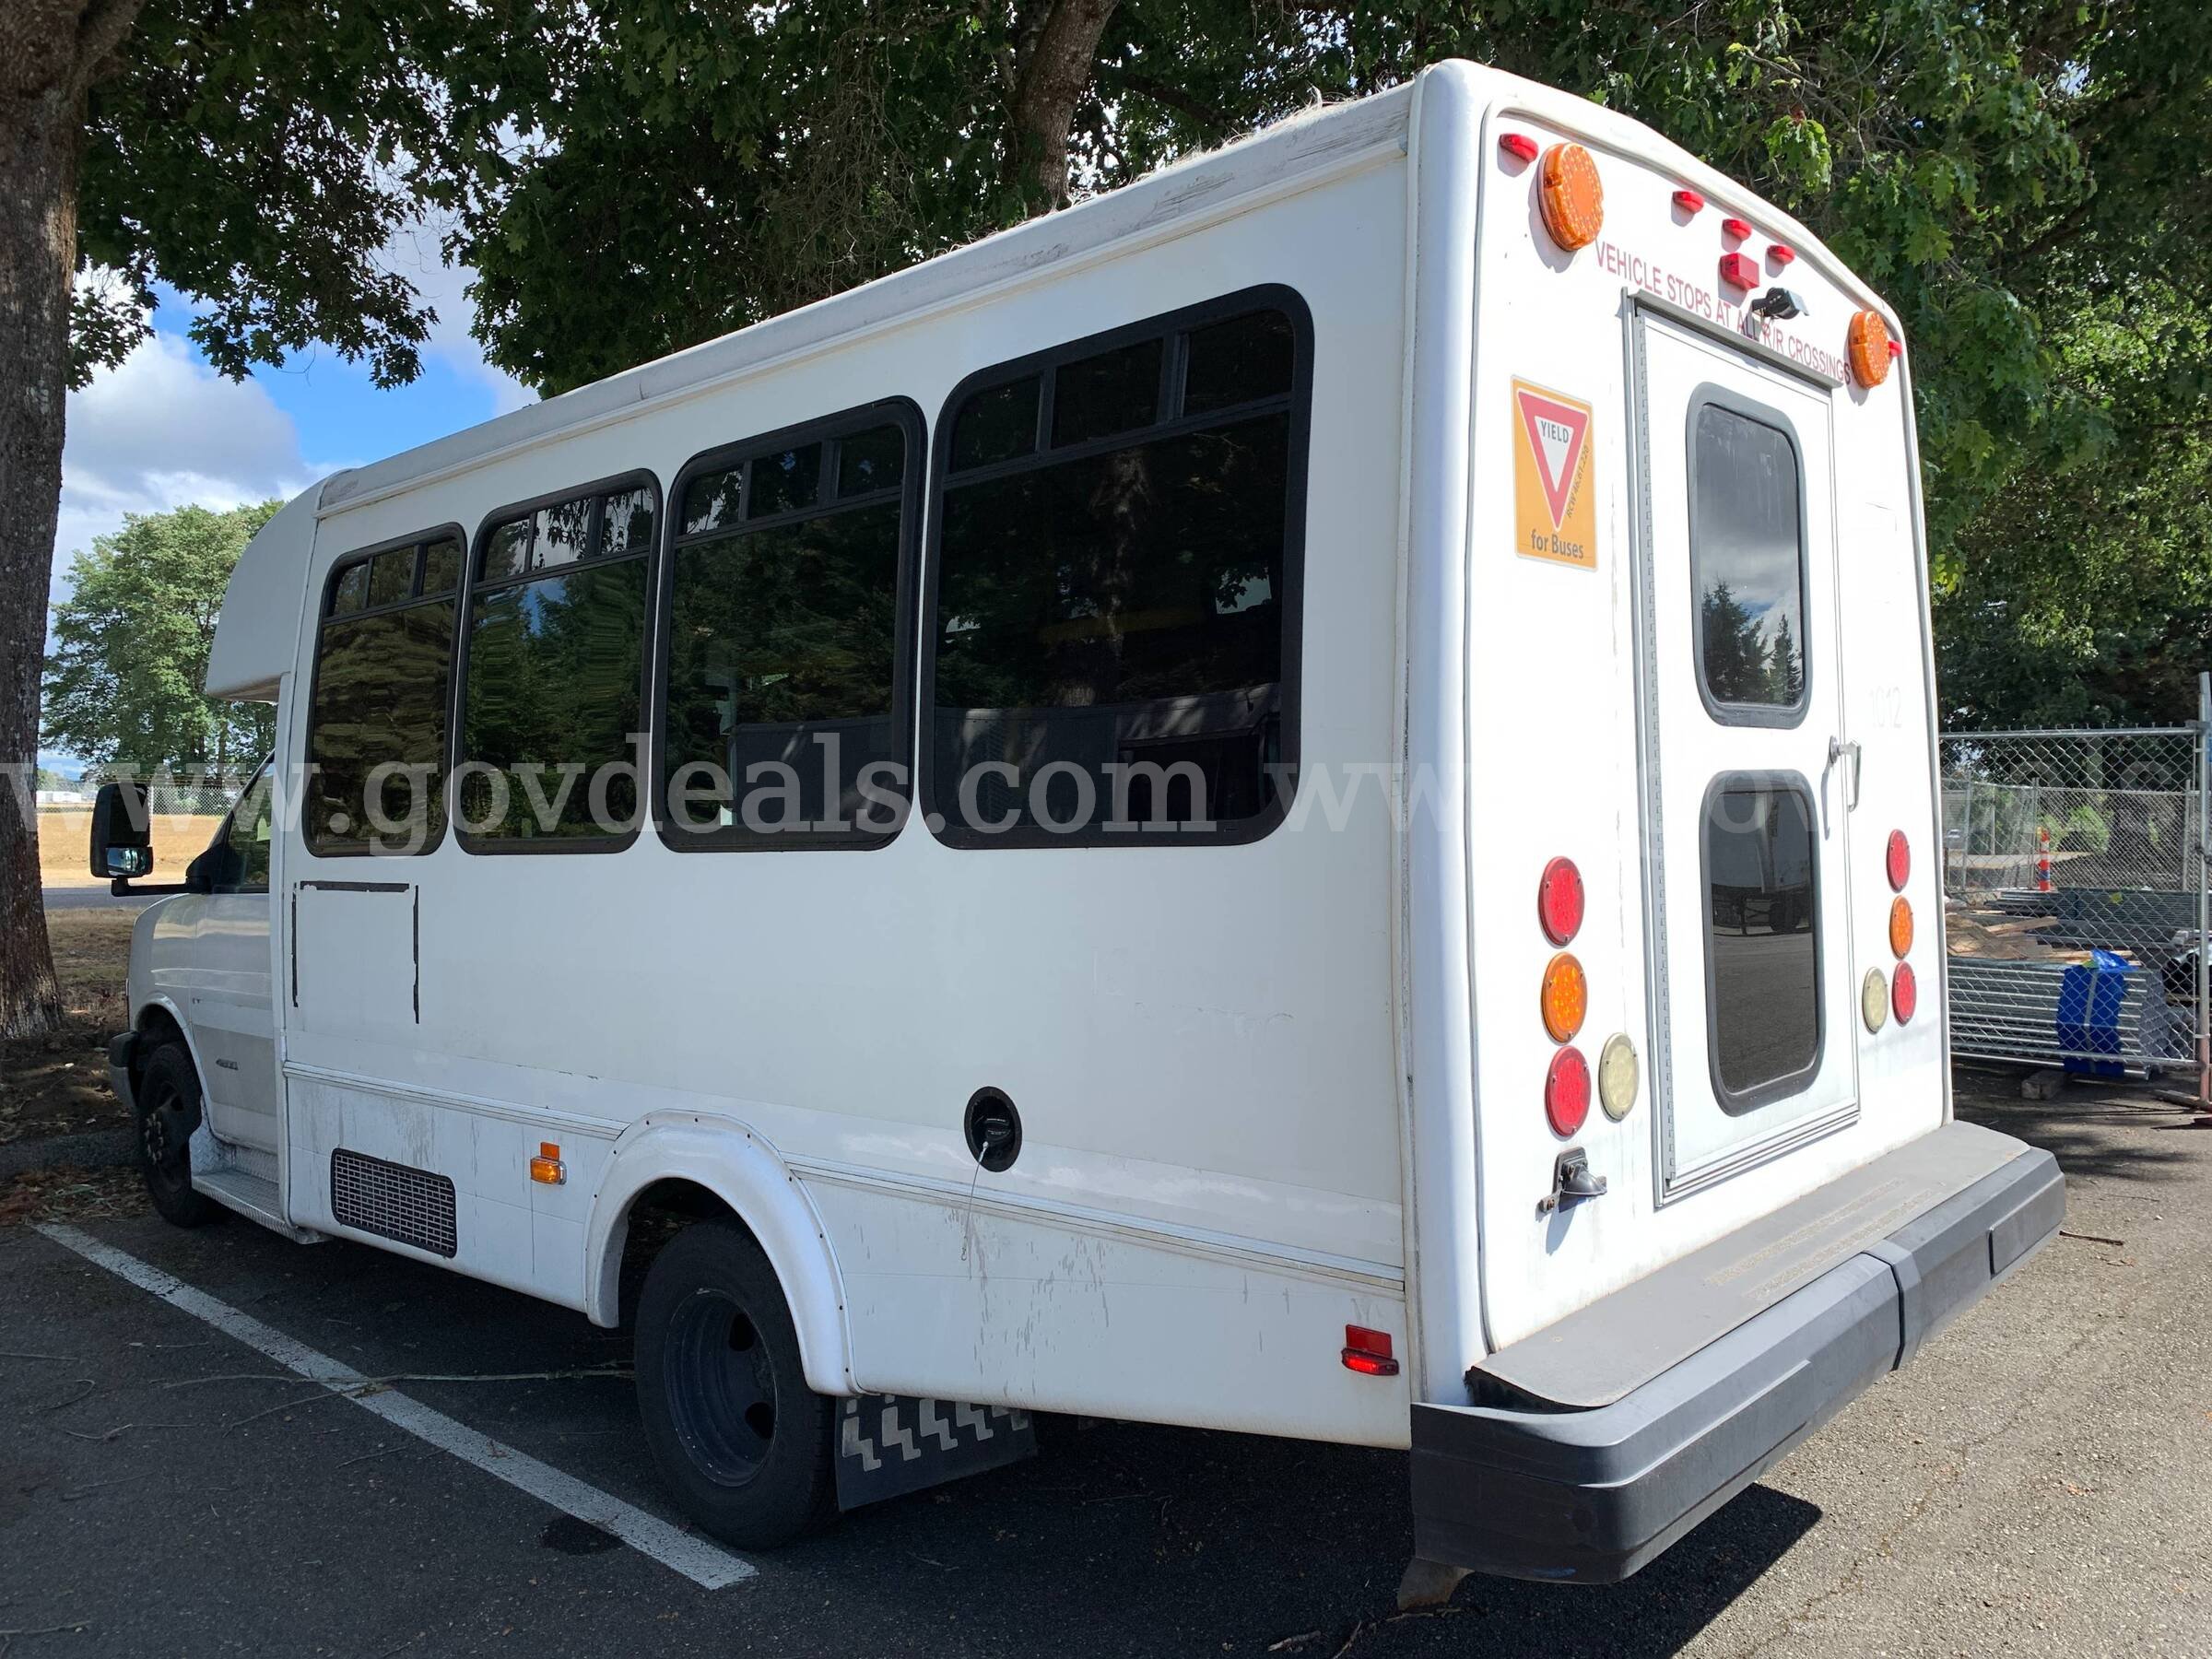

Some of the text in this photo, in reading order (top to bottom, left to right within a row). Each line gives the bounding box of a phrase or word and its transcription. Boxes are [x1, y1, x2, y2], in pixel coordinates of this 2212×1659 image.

[1594, 238, 1663, 296] VEHICLE
[1666, 274, 1712, 319] STOPS
[1716, 299, 1732, 328] AT
[1737, 310, 1759, 342] ALL
[1788, 335, 1852, 386] CROSSINGS
[1540, 419, 1570, 444] YIELD
[1531, 528, 1584, 560] for Buses
